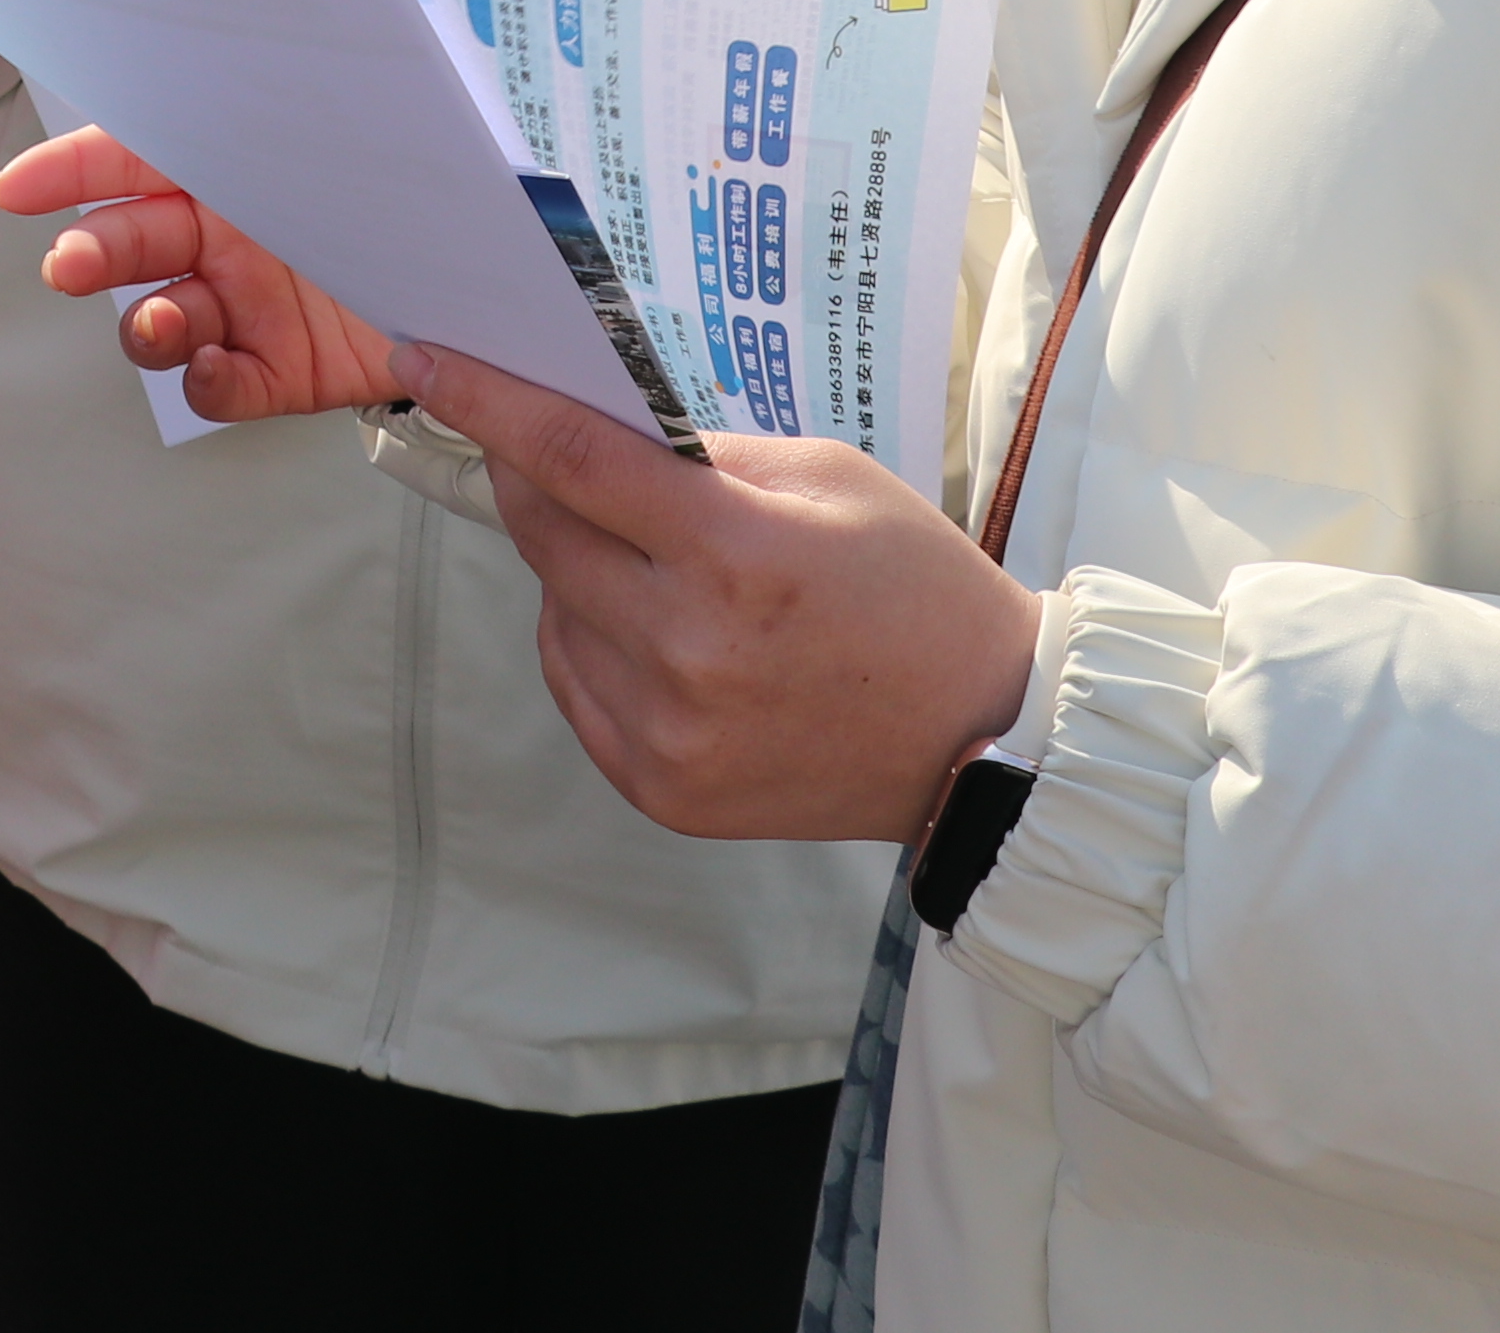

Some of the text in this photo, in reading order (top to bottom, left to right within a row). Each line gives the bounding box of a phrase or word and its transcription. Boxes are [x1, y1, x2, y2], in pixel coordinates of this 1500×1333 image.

[730, 51, 754, 150] 带薪年假
[769, 67, 790, 140] 工作餐
[730, 183, 750, 295] 8小时工作制
[764, 197, 782, 296] 公费培训
[696, 232, 726, 346] 公司福利
